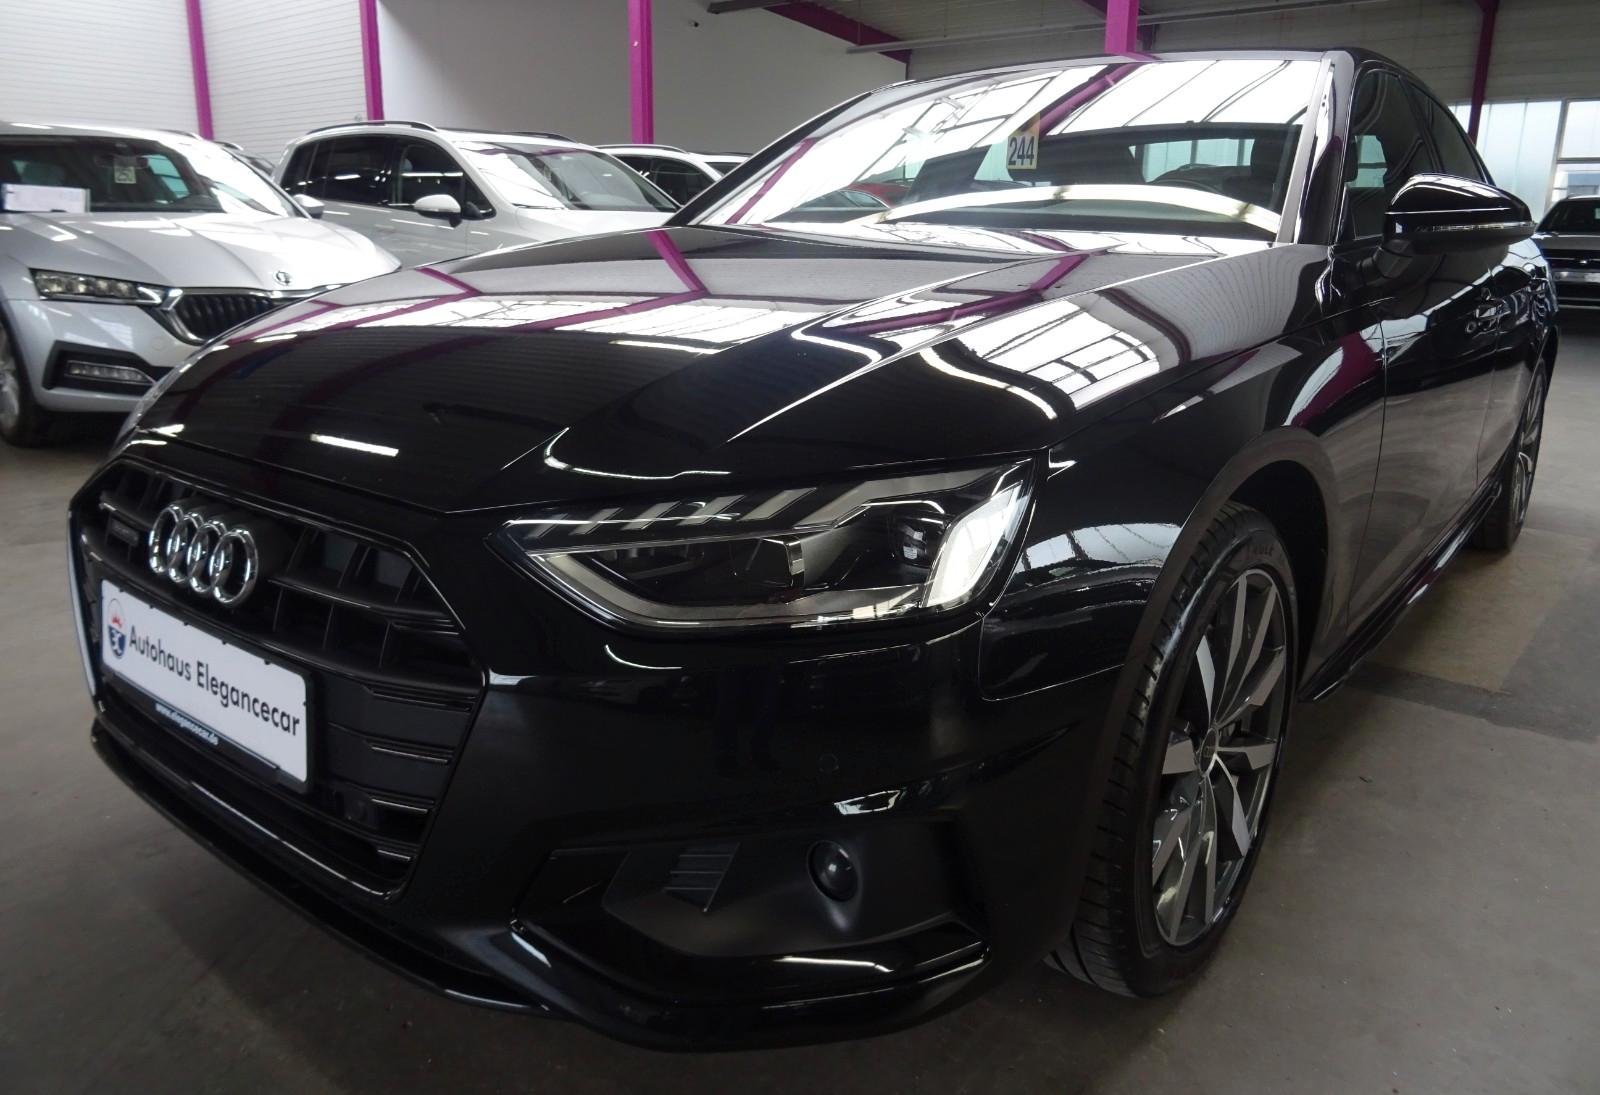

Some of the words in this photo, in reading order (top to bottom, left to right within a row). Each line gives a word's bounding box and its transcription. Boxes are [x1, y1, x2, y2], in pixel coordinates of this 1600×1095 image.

[1008, 136, 1035, 166] 244
[129, 625, 192, 682] Autohaus
[197, 660, 300, 736] Elegancecar
